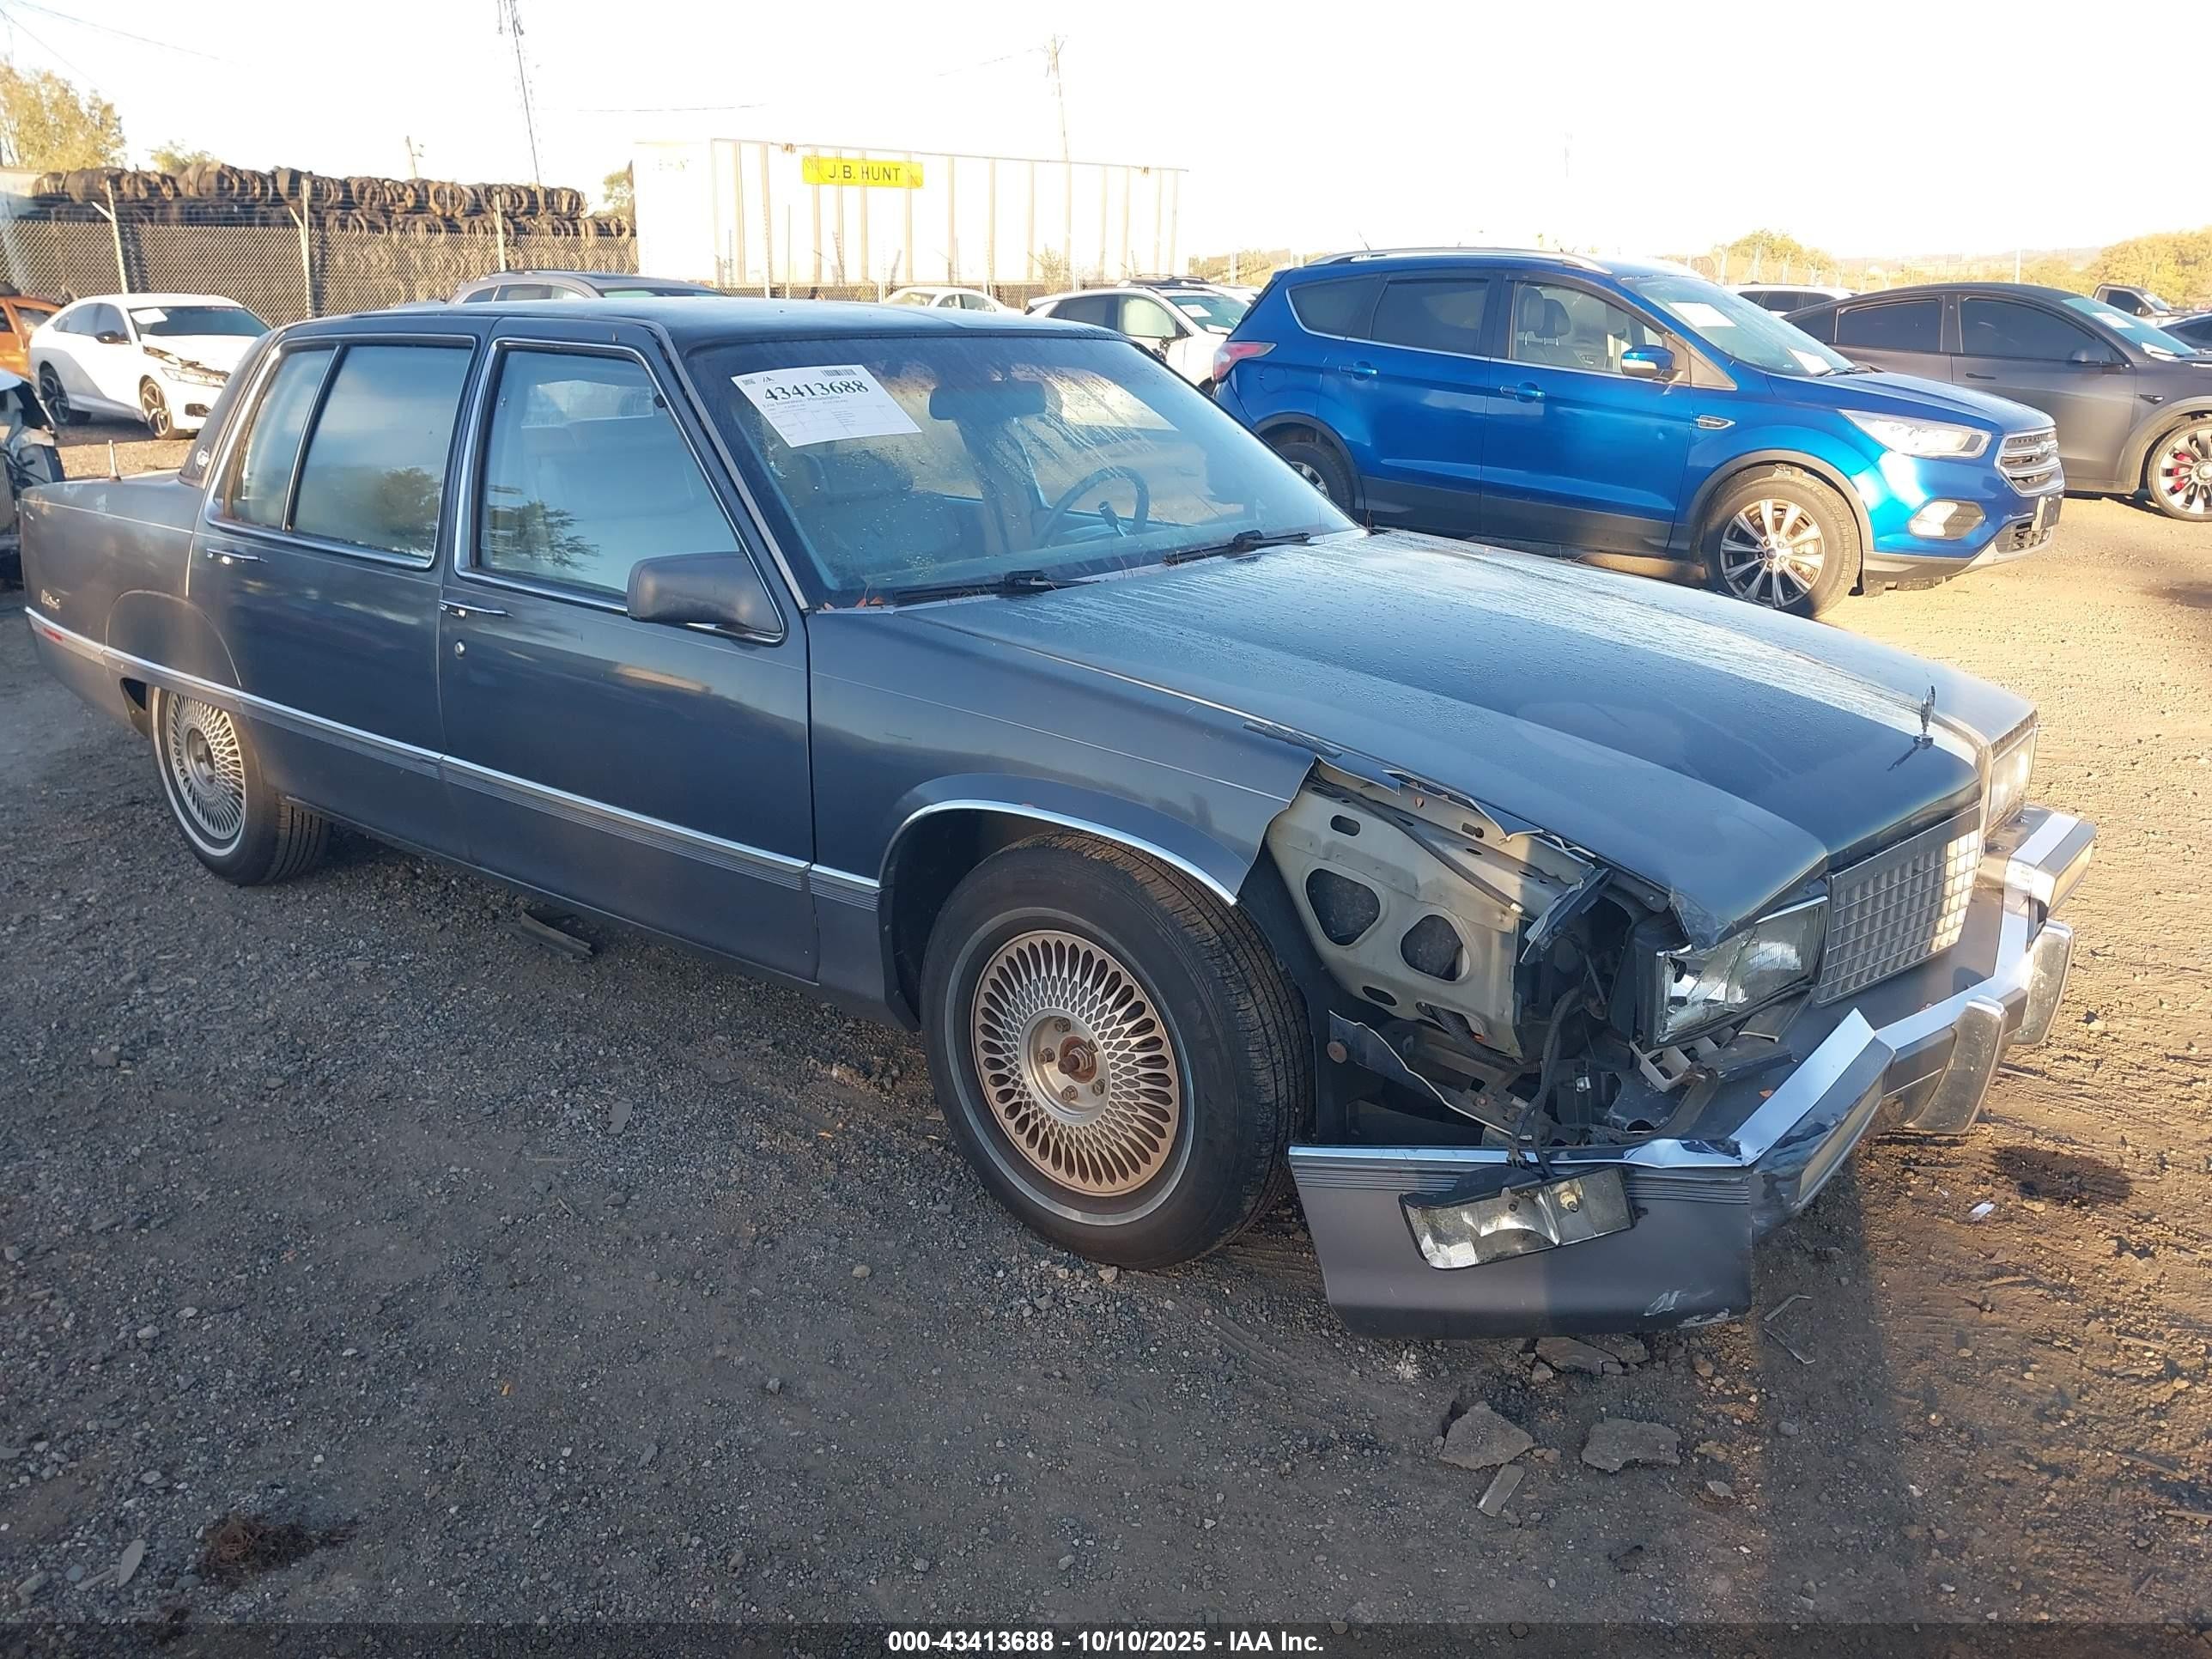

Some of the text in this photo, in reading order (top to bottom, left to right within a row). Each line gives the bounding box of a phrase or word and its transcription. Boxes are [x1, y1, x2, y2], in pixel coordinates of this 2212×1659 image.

[828, 164, 901, 182] J.B. HUNT
[764, 380, 869, 401] 43413688
